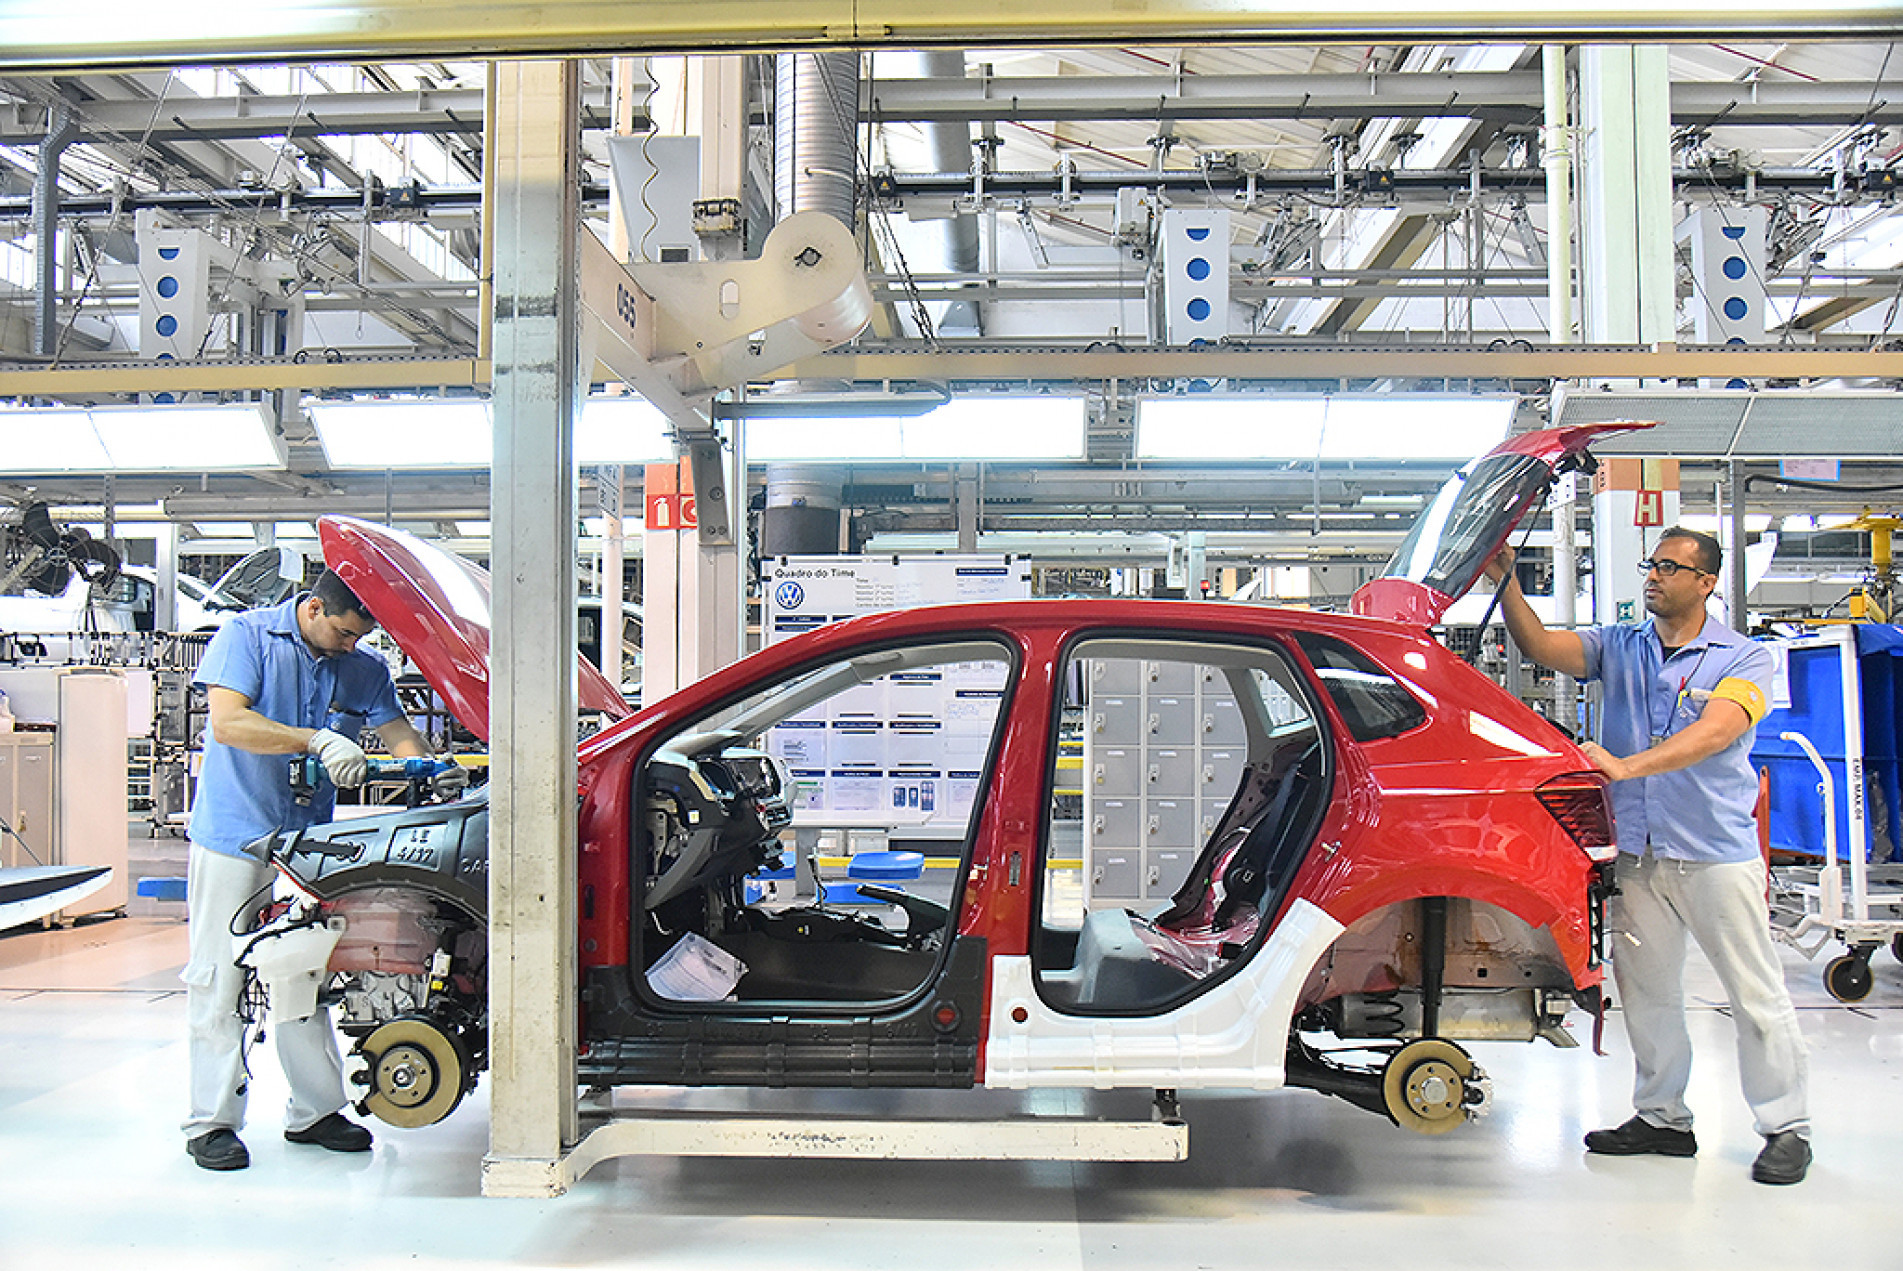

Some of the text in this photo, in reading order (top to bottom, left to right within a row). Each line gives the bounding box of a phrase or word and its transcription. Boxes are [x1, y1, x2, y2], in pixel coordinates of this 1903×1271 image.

[1637, 493, 1658, 523] H
[774, 568, 856, 579] Quadro do Time
